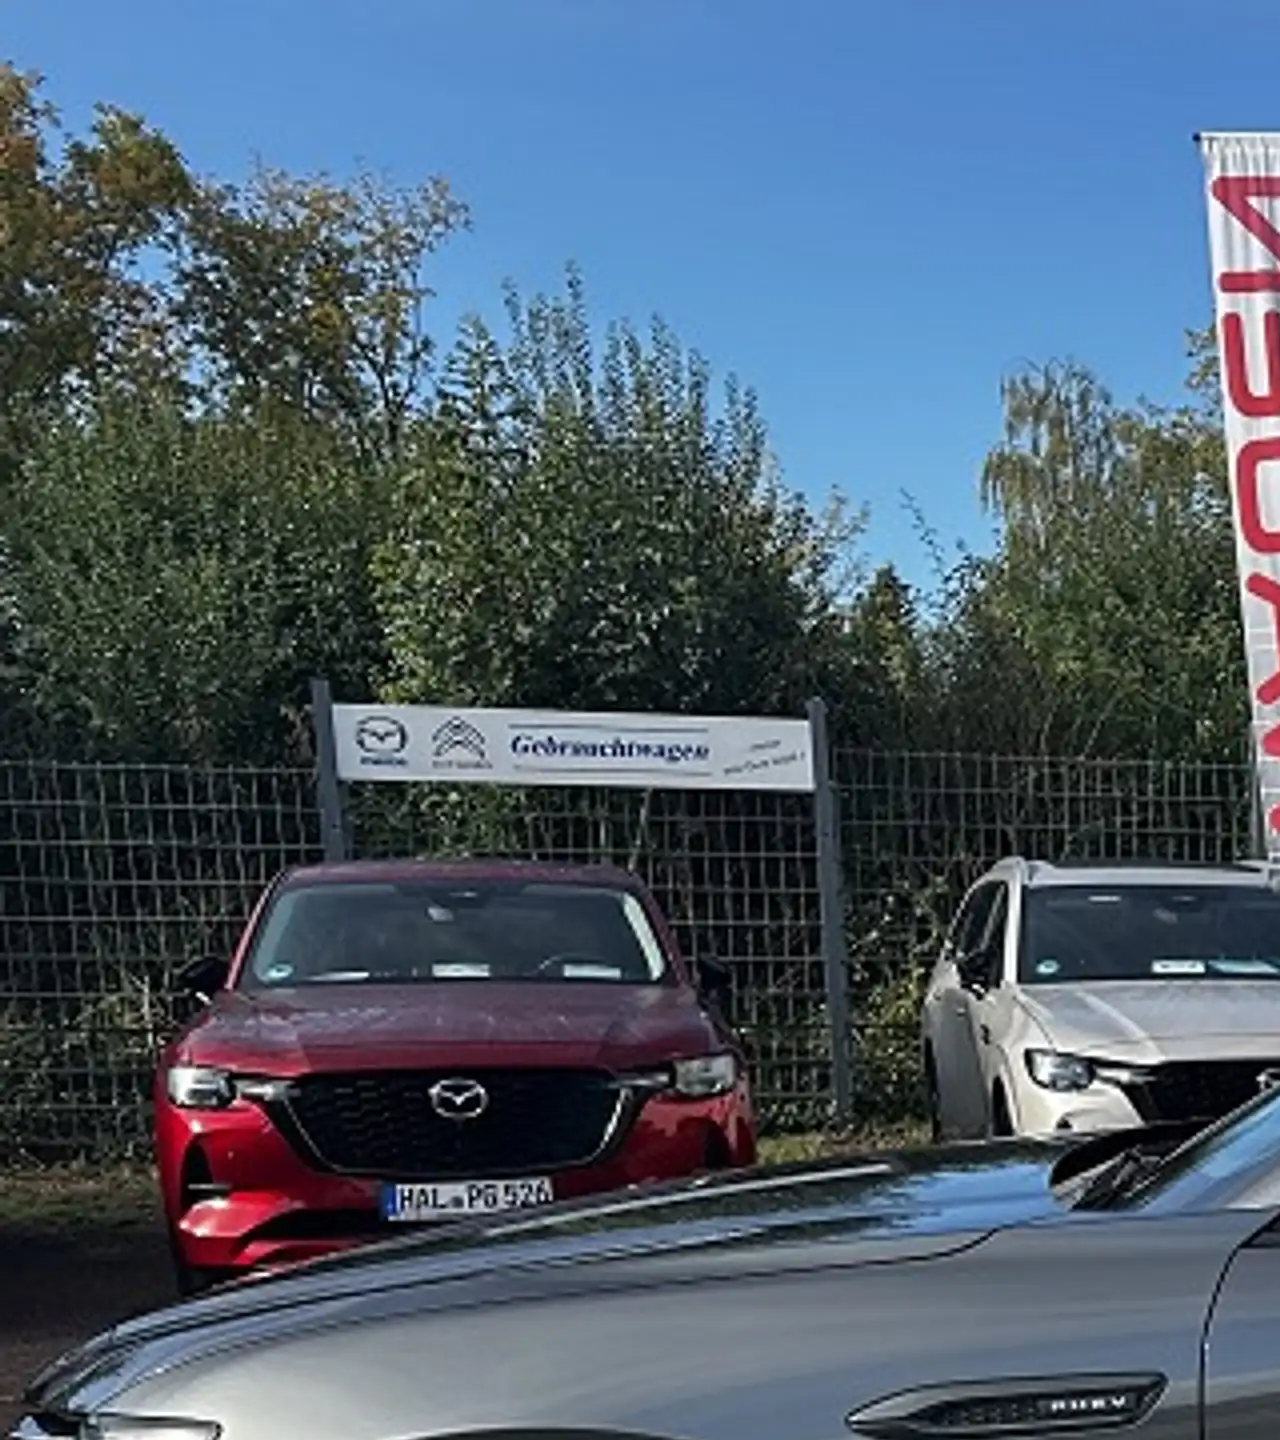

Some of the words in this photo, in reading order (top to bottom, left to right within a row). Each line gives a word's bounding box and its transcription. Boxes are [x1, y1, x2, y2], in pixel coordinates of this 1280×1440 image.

[510, 734, 710, 762] Gebrauchtwagen
[398, 1185, 447, 1210] HAL
[504, 1178, 553, 1208] 526
